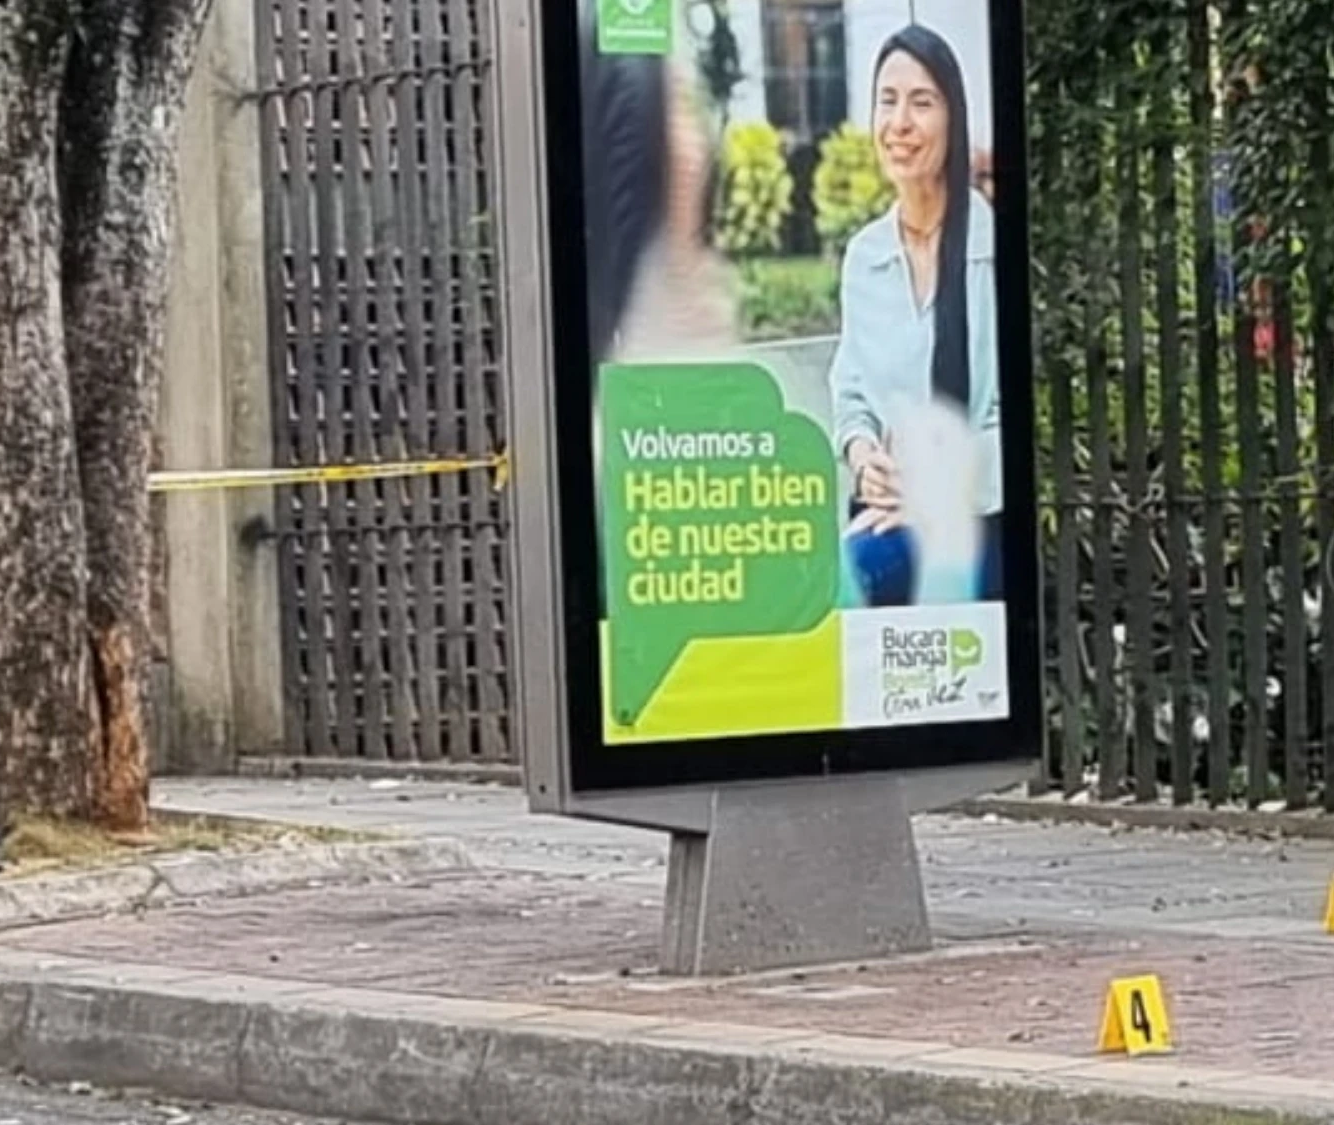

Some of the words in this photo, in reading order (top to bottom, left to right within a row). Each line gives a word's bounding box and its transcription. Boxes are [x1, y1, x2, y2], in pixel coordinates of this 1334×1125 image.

[621, 425, 755, 461] Volvamos
[758, 431, 776, 458] a
[624, 464, 745, 513] Hablar
[750, 463, 826, 508] bien
[626, 512, 672, 560] de
[679, 514, 812, 557] nuestra
[627, 556, 743, 606] ciudad
[883, 626, 947, 649] Bucara
[883, 648, 947, 673] manga
[1131, 989, 1152, 1044] 4
